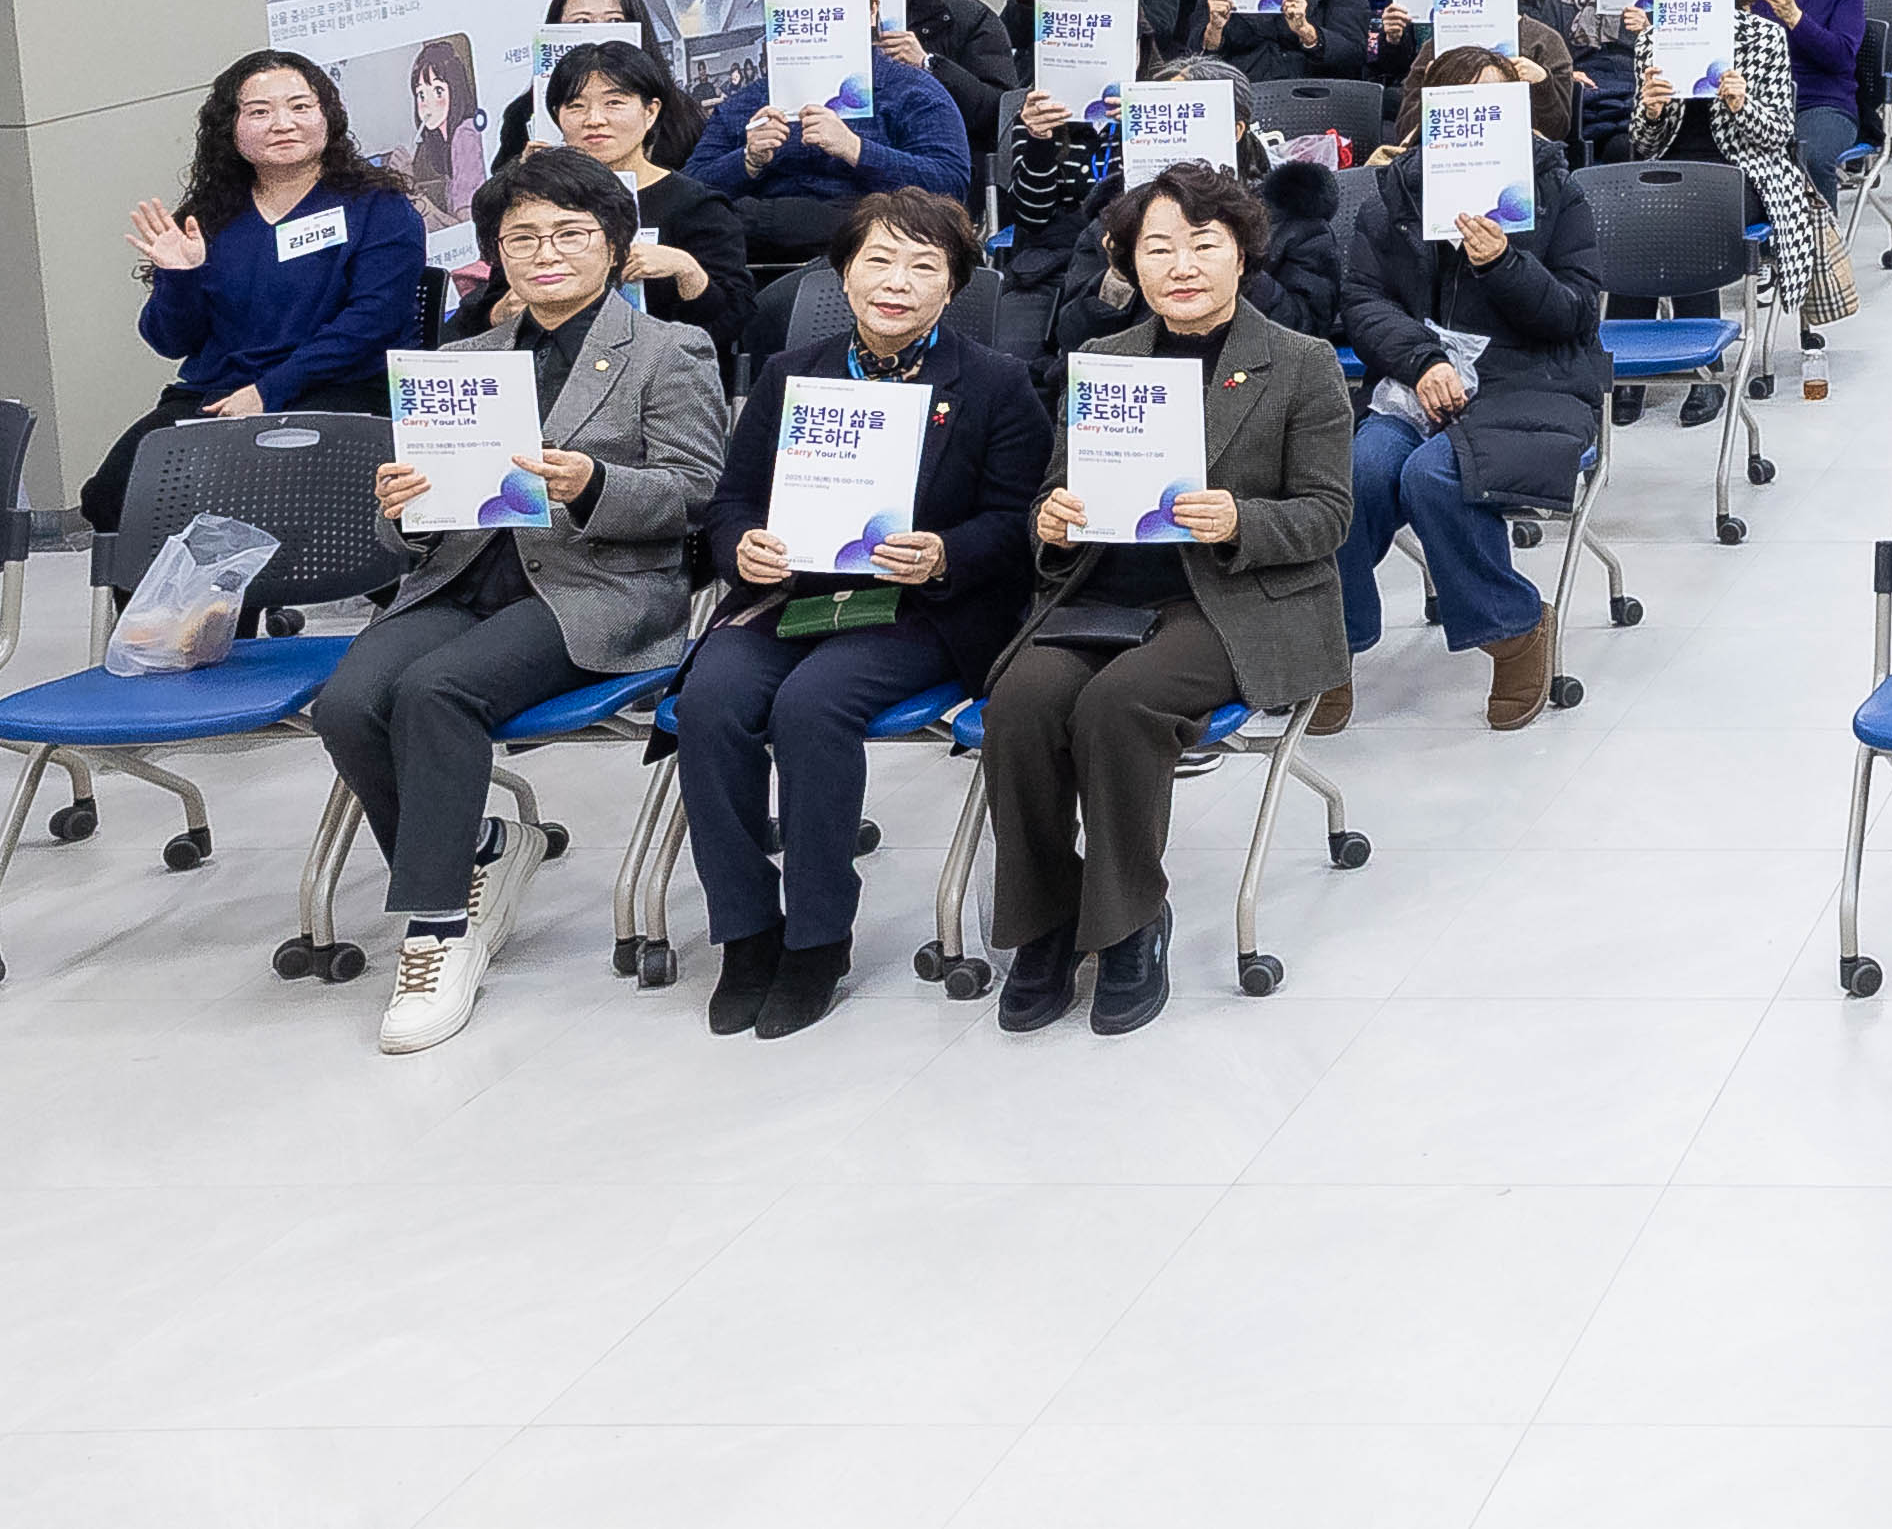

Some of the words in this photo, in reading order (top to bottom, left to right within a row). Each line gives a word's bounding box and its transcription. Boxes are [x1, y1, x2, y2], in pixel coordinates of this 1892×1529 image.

[772, 8, 814, 23] 청년의
[817, 6, 847, 21] 삶을
[773, 21, 829, 36] 주도하다
[1428, 107, 1470, 124] 청년의
[1473, 104, 1502, 121] 삶을
[1428, 122, 1485, 140] 주도하다
[398, 378, 455, 396] 청년의
[460, 377, 500, 396] 삶을
[1076, 381, 1127, 402] 청년의
[1132, 384, 1168, 404] 삶을
[400, 397, 477, 415] 주도하다
[1076, 401, 1145, 423] 주도하다
[401, 417, 430, 427] Carry
[430, 418, 456, 426] Your
[456, 417, 478, 426] Life
[792, 404, 844, 427] 청년의
[849, 409, 887, 429] 삶을
[789, 425, 861, 448] 주도하다
[1075, 421, 1102, 433] Carry
[1102, 424, 1125, 433] Your
[1125, 425, 1145, 434] Life
[787, 445, 814, 458] Carry
[814, 449, 838, 458] Your
[838, 450, 858, 459] Life
